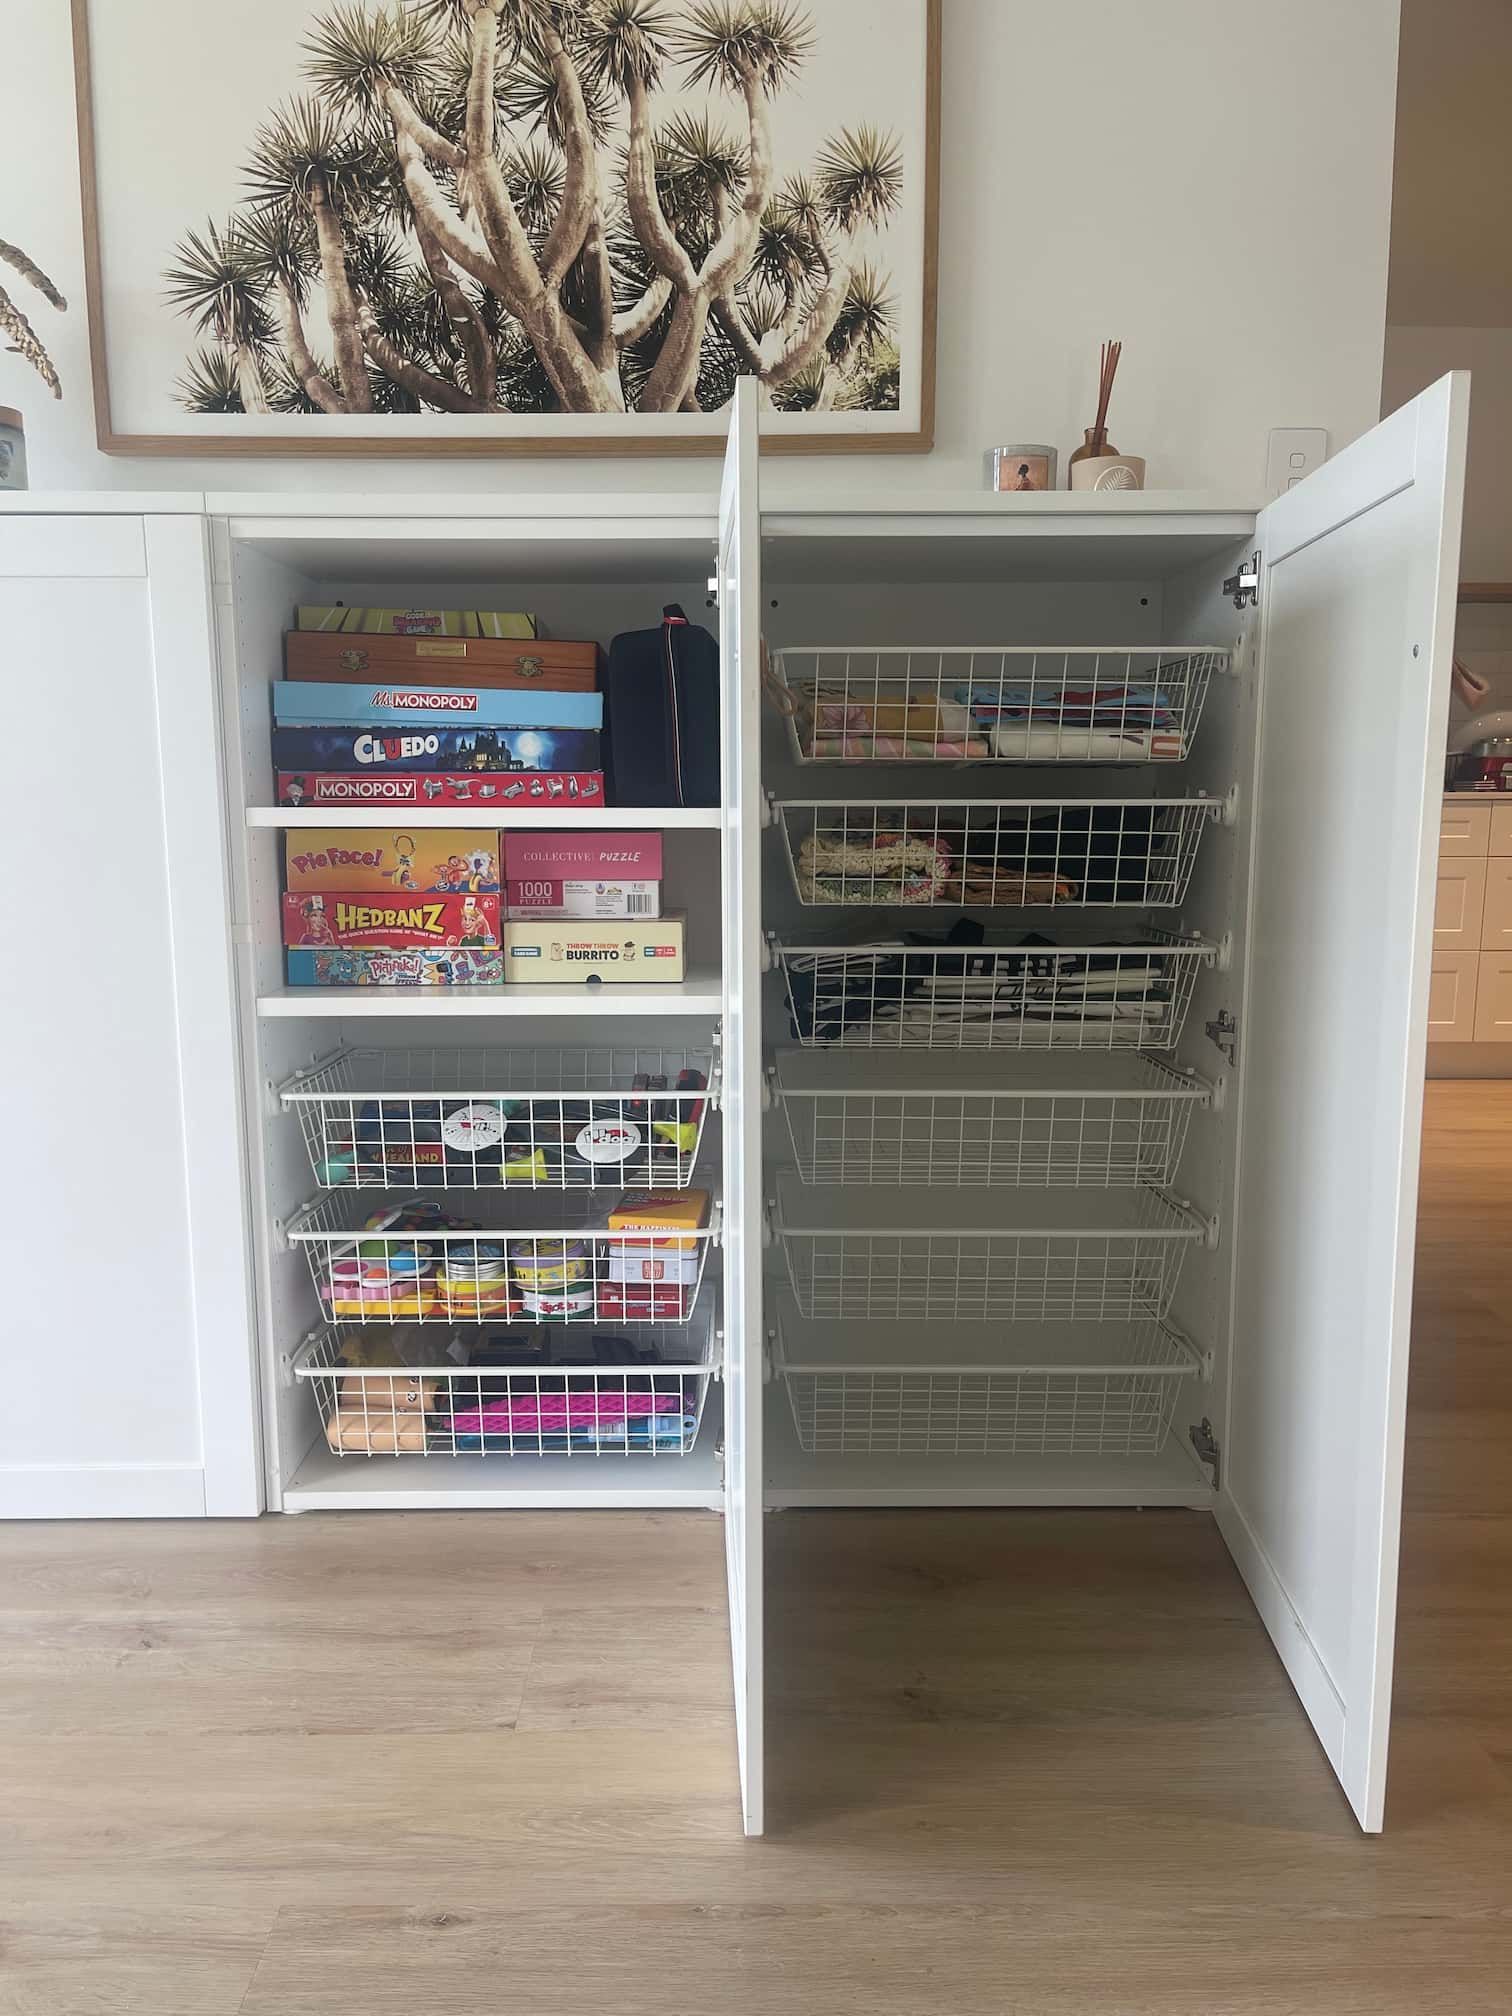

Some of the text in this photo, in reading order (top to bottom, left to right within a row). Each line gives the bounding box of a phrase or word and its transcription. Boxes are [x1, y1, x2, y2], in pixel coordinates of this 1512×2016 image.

[394, 694, 476, 710] MONOPOLY
[354, 734, 439, 763] CLUEDO
[320, 782, 413, 797] MONOPOLY
[291, 847, 384, 874] Pie Face!
[523, 851, 641, 863] COLLECTIVE PUZZLE
[518, 882, 552, 897] 1000
[335, 902, 446, 934] HEDBANZ
[566, 950, 619, 960] BURRITO
